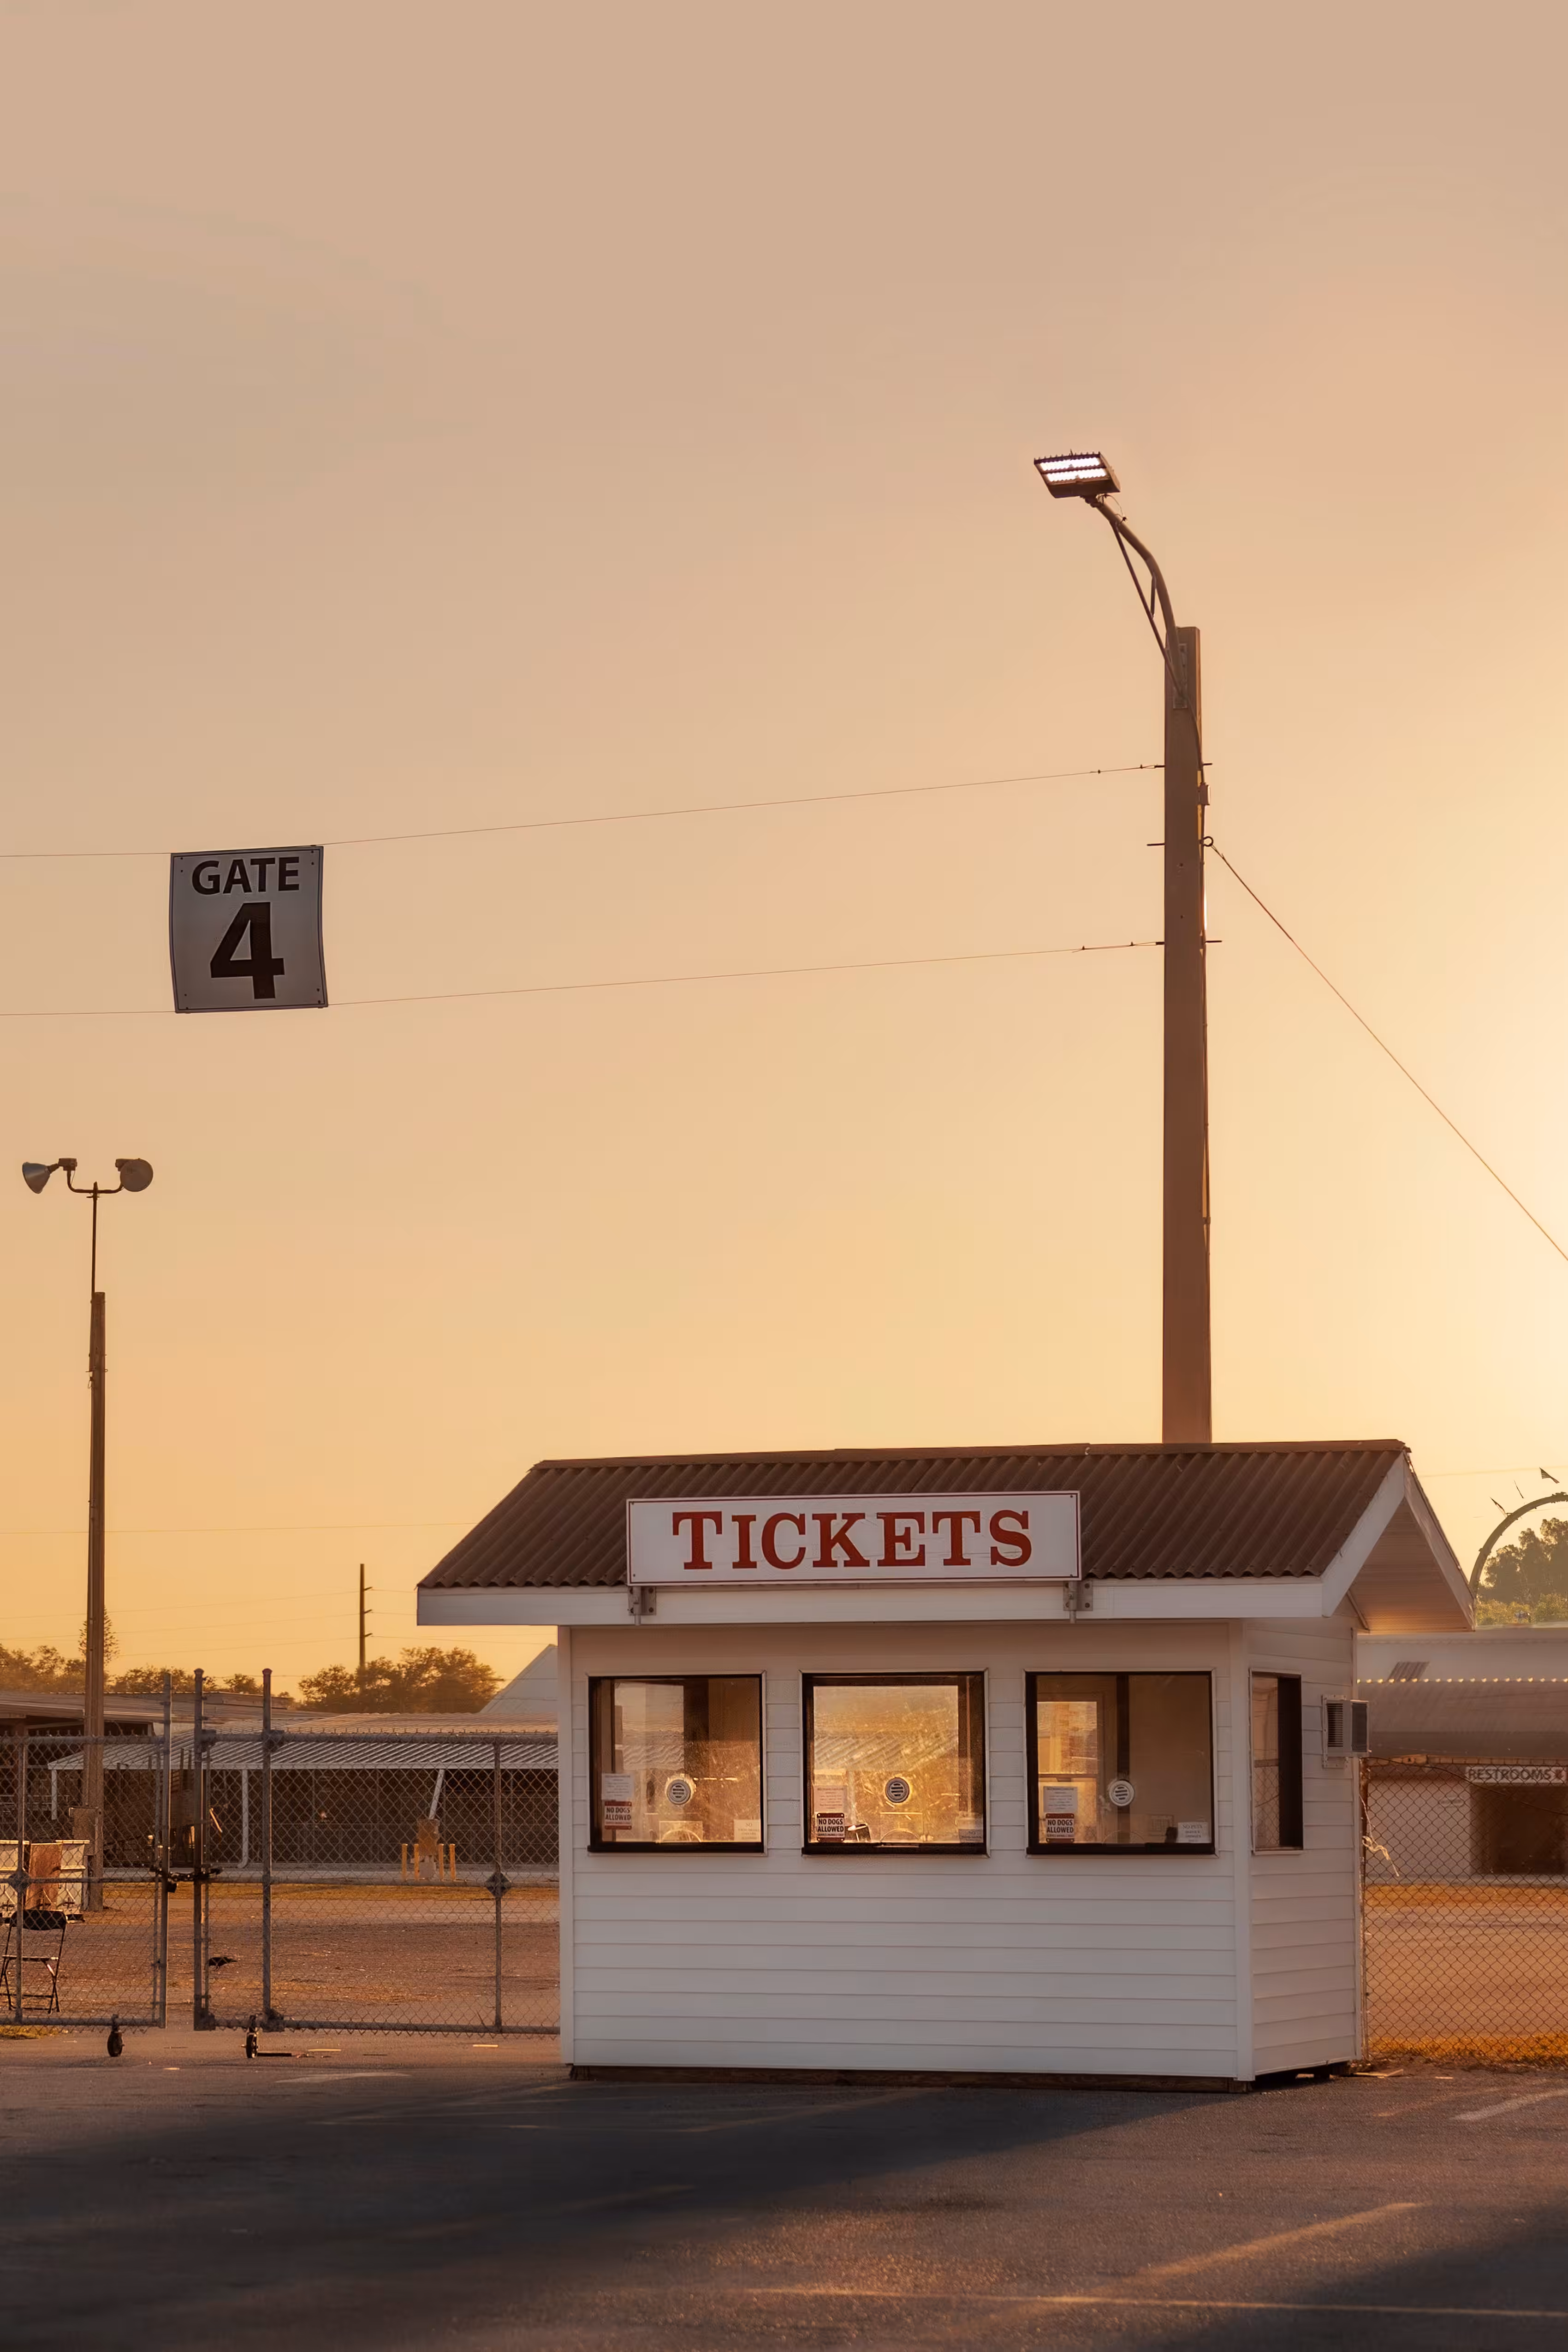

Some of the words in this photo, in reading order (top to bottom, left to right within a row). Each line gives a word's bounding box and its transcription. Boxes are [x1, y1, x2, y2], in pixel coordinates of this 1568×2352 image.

[191, 856, 300, 895] GATE
[209, 902, 285, 999] 4
[672, 1509, 1032, 1569] TICKETS
[1468, 1769, 1551, 1781] RESTROOMS
